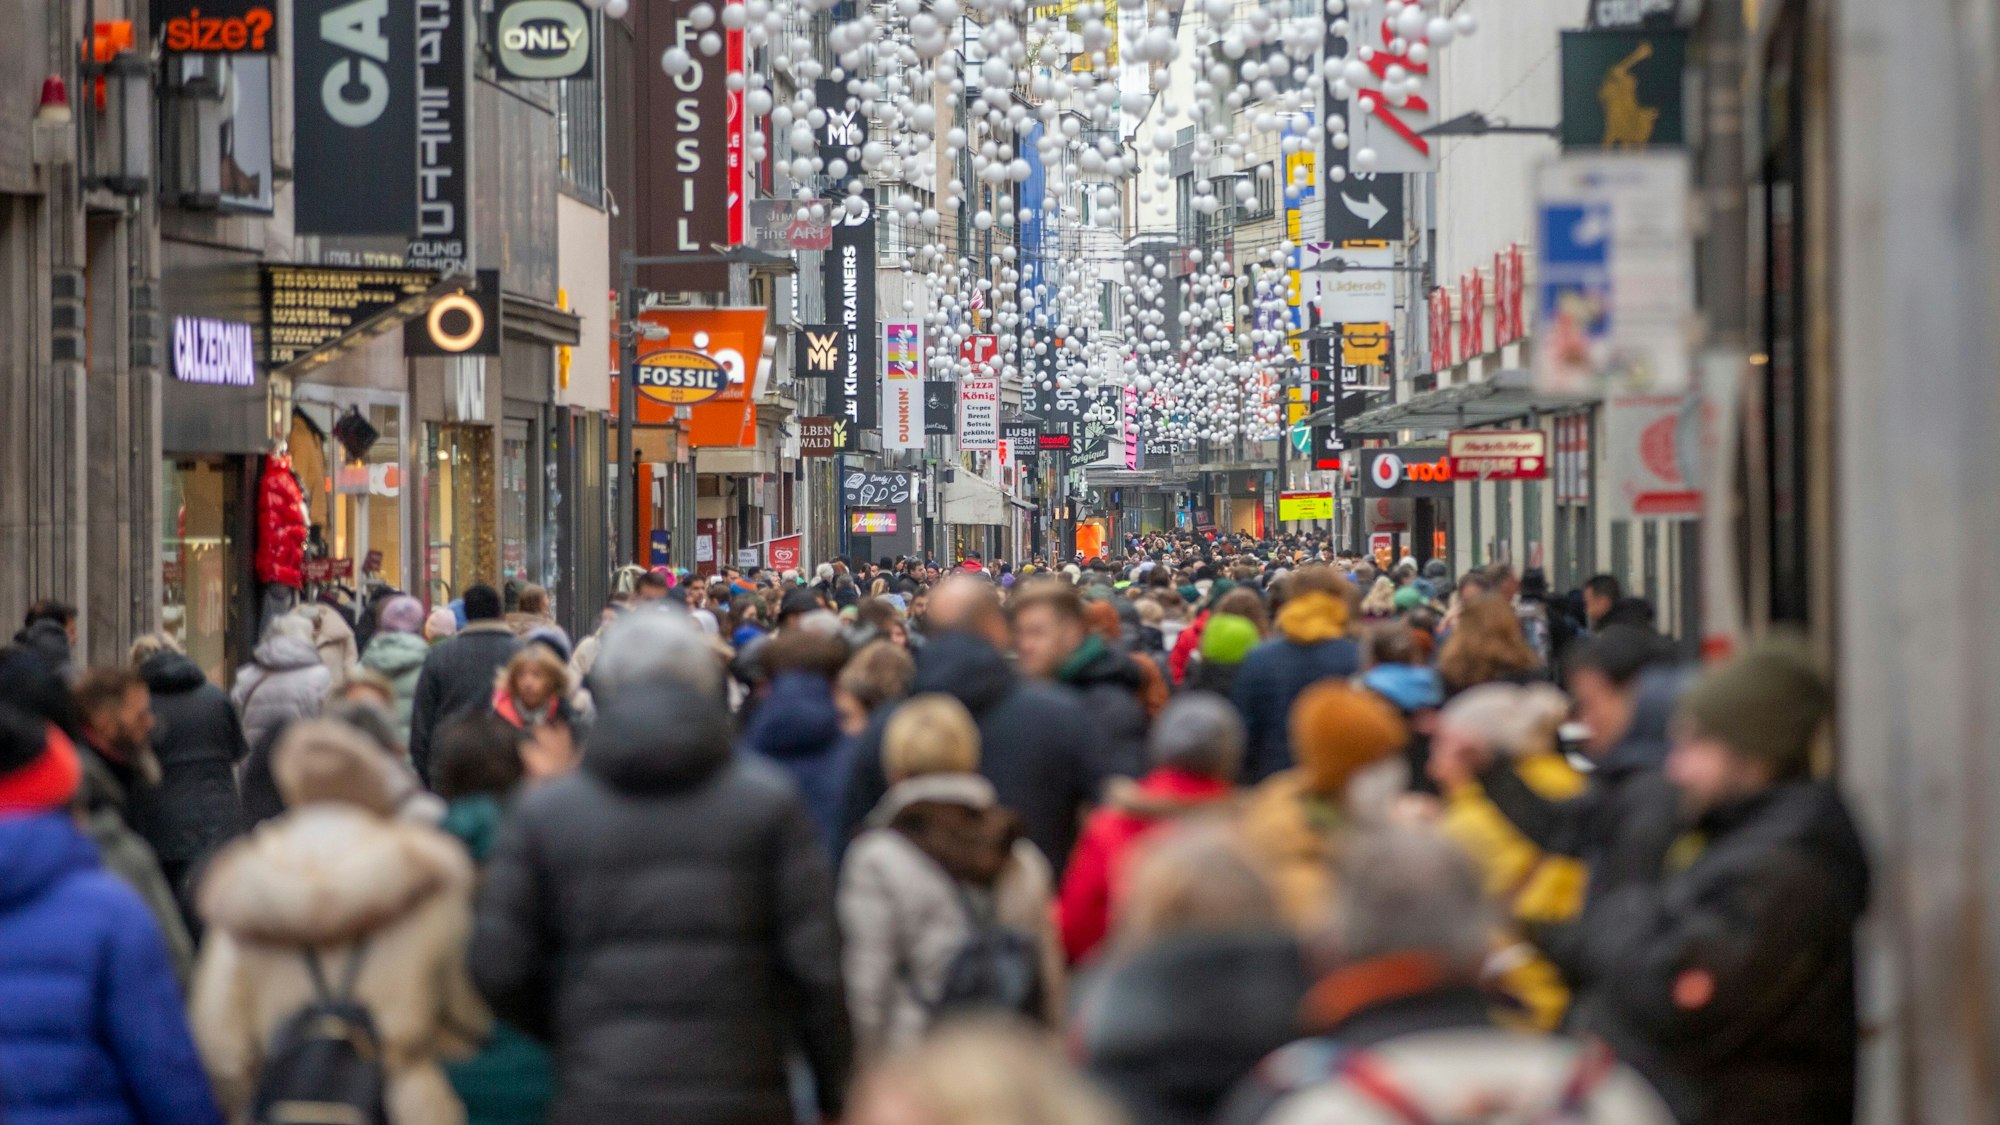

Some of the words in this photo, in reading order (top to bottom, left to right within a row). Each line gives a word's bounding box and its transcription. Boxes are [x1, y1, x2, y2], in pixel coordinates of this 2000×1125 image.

[167, 7, 273, 51] size?
[504, 28, 582, 50] ONLY
[672, 19, 704, 251] FOSSIL
[754, 227, 787, 240] Fine
[793, 227, 825, 240] ART
[174, 316, 254, 386] CALZEDONIA
[806, 331, 838, 371] WMF
[638, 366, 718, 389] FOSSIL
[963, 391, 995, 401] König
[899, 387, 909, 443] DUNKIN'
[1006, 428, 1036, 436] LUSH
[799, 437, 831, 447] WALD
[1145, 444, 1169, 454] Fast.
[1071, 450, 1106, 464] Belgique
[1407, 456, 1451, 482] vod
[870, 475, 891, 484] Candy!
[853, 515, 896, 530] jamin
